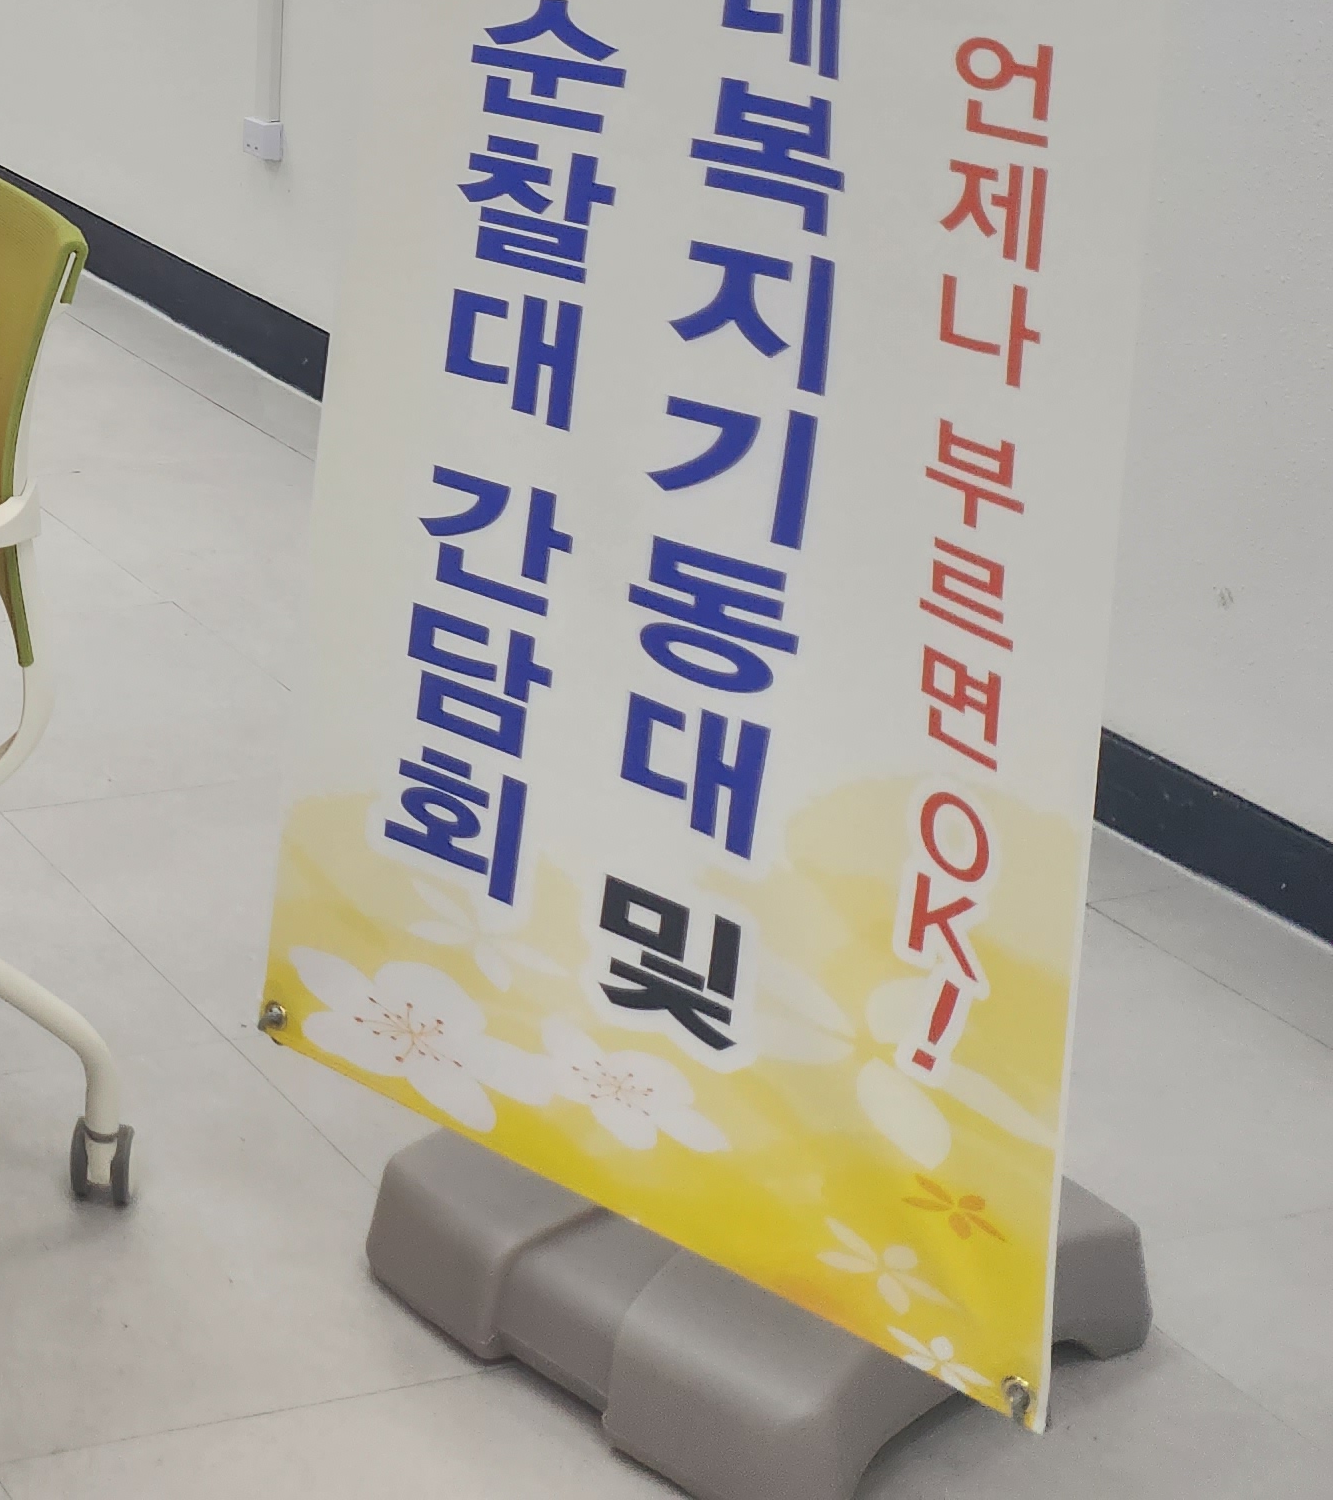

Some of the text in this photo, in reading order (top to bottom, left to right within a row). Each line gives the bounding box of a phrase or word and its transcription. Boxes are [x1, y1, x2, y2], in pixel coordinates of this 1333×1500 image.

[940, 36, 1053, 388] 언제나
[384, 464, 573, 906] 간담회
[919, 418, 1025, 771] 부르면
[598, 874, 741, 1050] 및
[908, 791, 989, 1071] OK!
